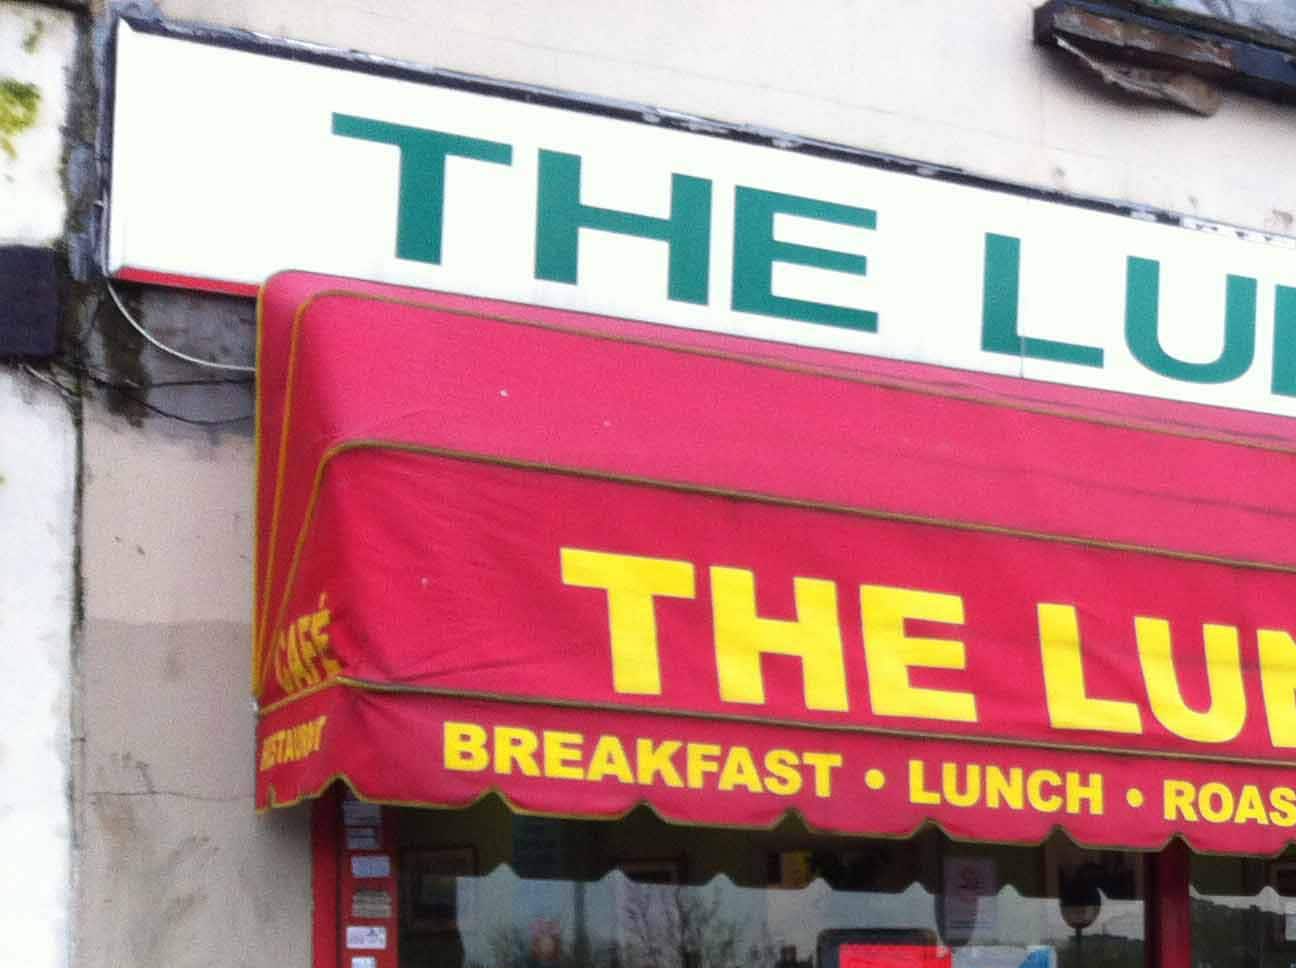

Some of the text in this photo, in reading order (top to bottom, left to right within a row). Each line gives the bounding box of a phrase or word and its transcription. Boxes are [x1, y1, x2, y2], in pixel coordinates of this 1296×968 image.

[331, 112, 879, 333] THE
[560, 546, 980, 723] THE
[443, 720, 843, 798] BREAKFAST
[908, 759, 1105, 816] LUNCH
